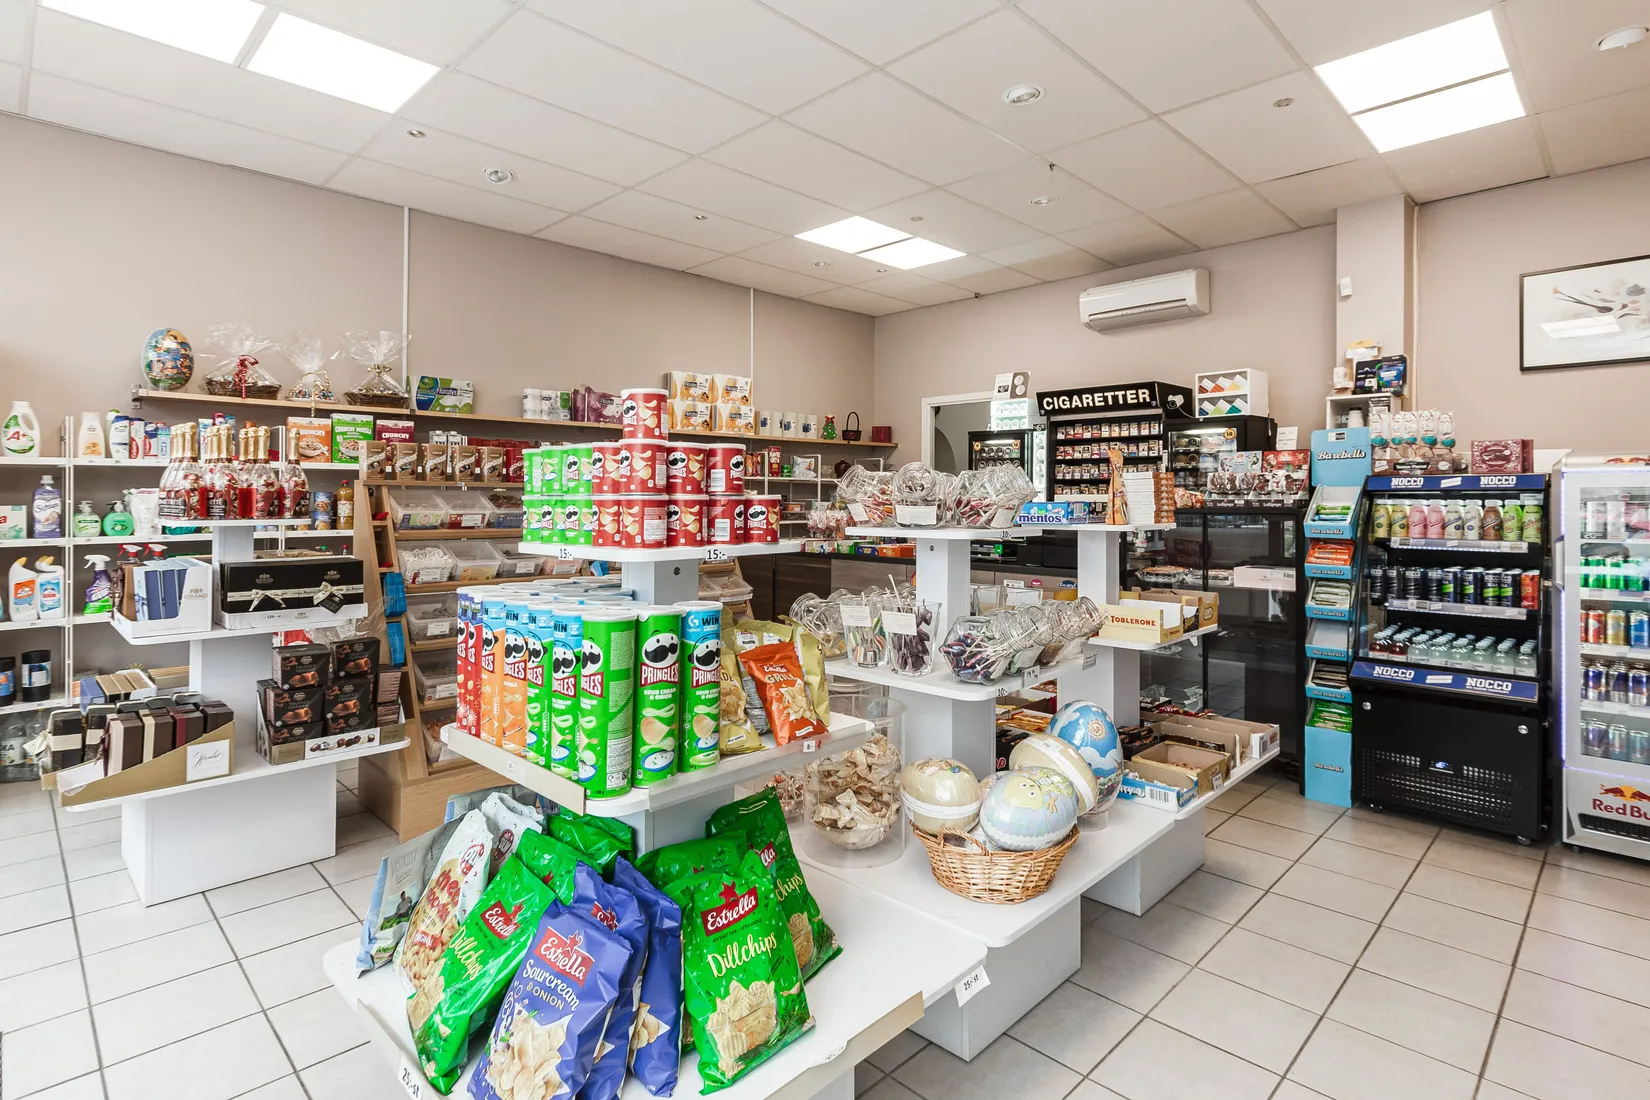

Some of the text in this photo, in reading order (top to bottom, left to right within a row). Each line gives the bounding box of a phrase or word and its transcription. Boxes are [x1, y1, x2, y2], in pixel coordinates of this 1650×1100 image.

[1042, 388, 1151, 410] CIGARETTER
[1316, 449, 1366, 461] Barebells
[1391, 477, 1424, 486] NOCCO
[1480, 476, 1516, 485] NOCCO
[1018, 513, 1062, 523] mentos
[560, 549, 573, 559] 15:-
[707, 550, 726, 559] 15:-
[1111, 615, 1156, 627] TOBLERONE
[641, 669, 679, 687] PRINGLES
[765, 672, 798, 684] GRILL
[1373, 665, 1415, 679] NOCCO
[1465, 677, 1512, 692] NOCCO
[643, 690, 658, 698] SOUR
[1591, 798, 1650, 822] Red Bu
[707, 895, 756, 931] Estrella
[448, 925, 483, 981] Dillchips
[540, 937, 586, 981] Estrella
[707, 932, 777, 979] Dillchips
[523, 958, 580, 1011] Sourcream
[533, 986, 565, 1010] ONION
